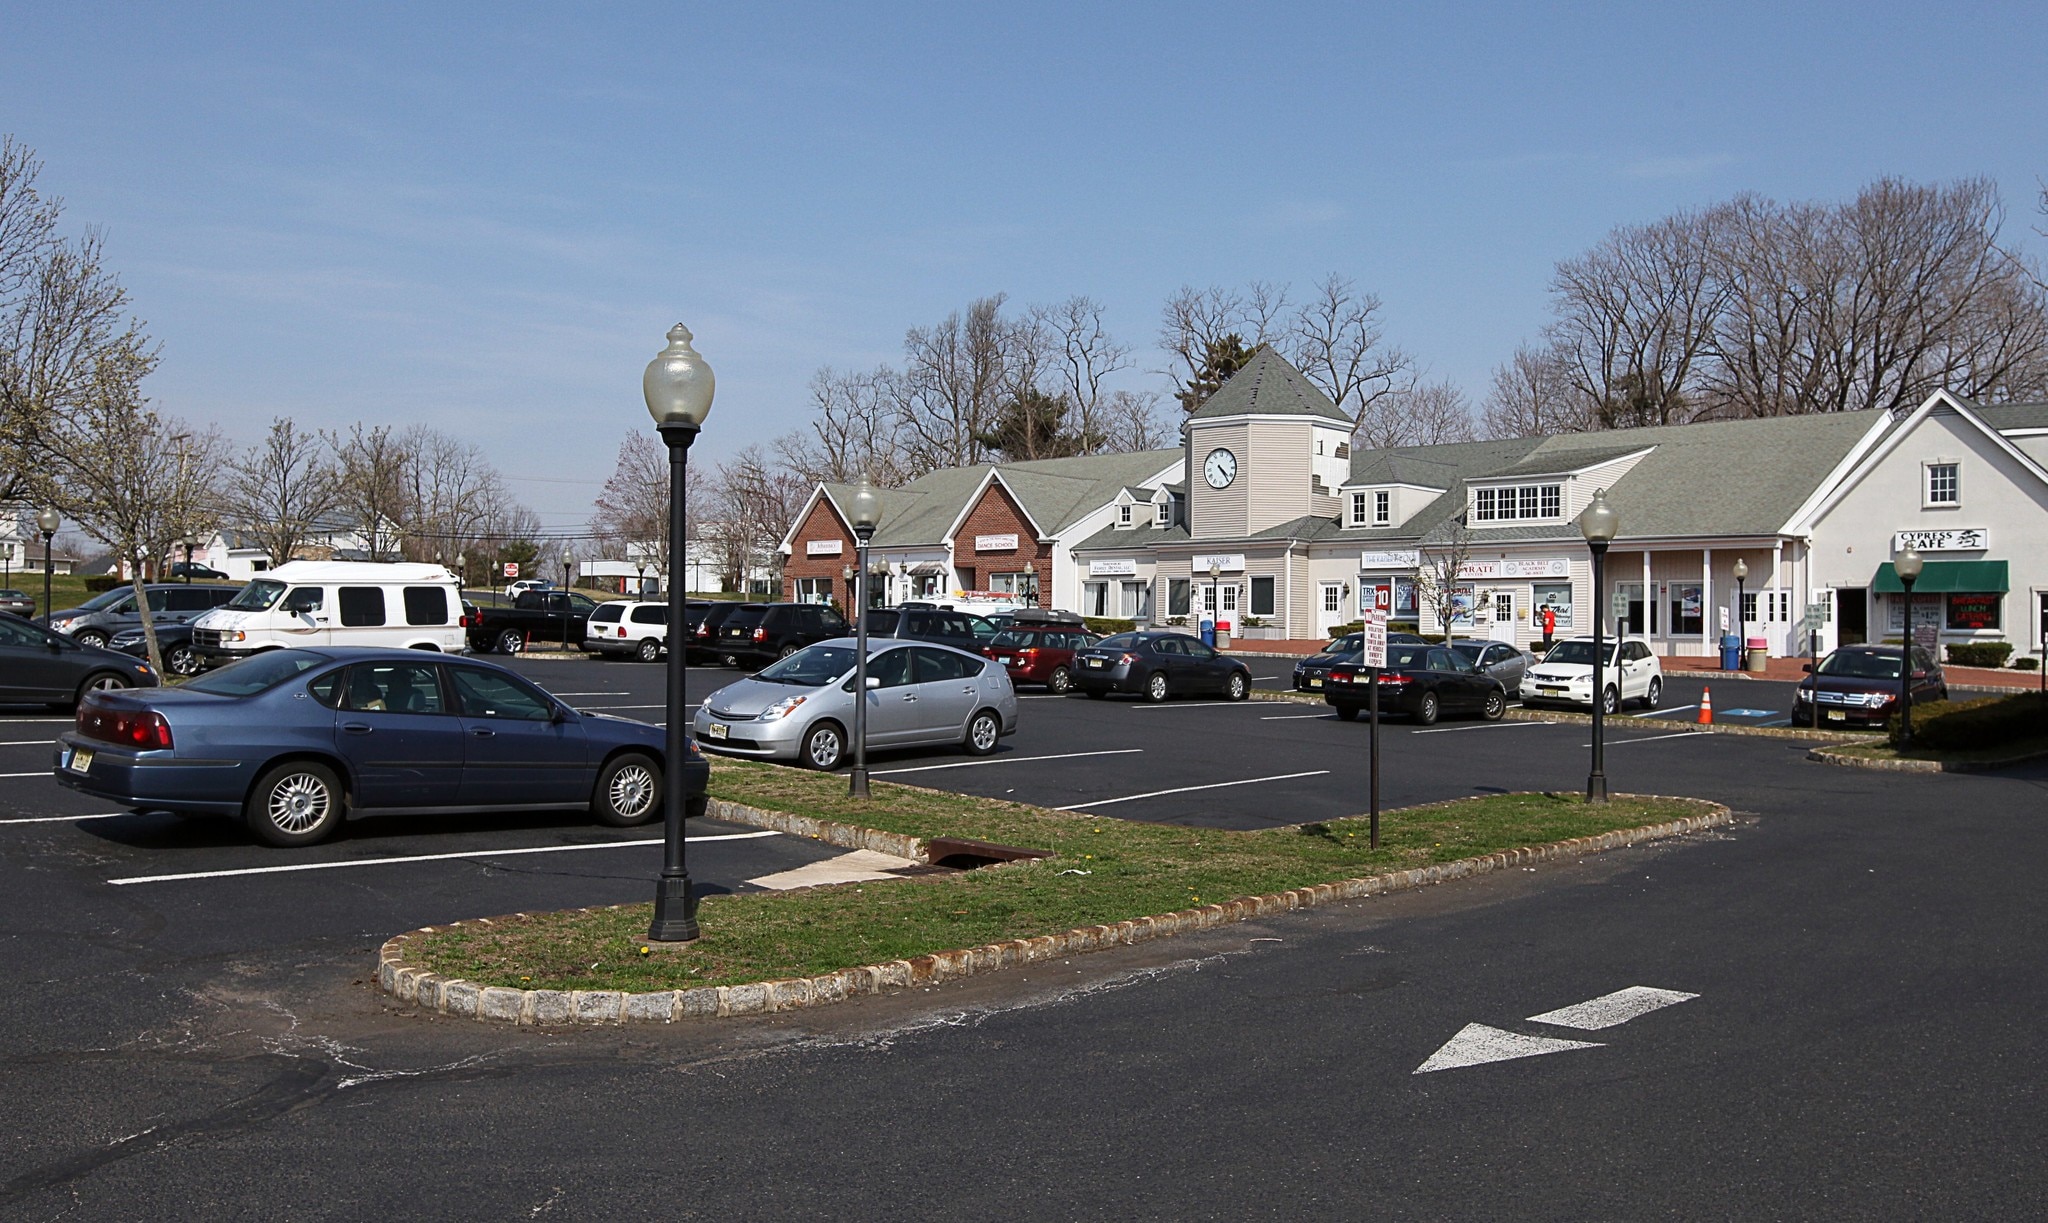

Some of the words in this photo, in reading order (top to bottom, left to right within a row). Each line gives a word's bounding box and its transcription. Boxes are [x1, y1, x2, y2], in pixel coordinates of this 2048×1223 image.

[1900, 532, 1953, 541] CYPRESS
[1206, 556, 1231, 565] KAISER
[1362, 587, 1375, 596] TRX
[1371, 613, 1386, 623] PARKING
